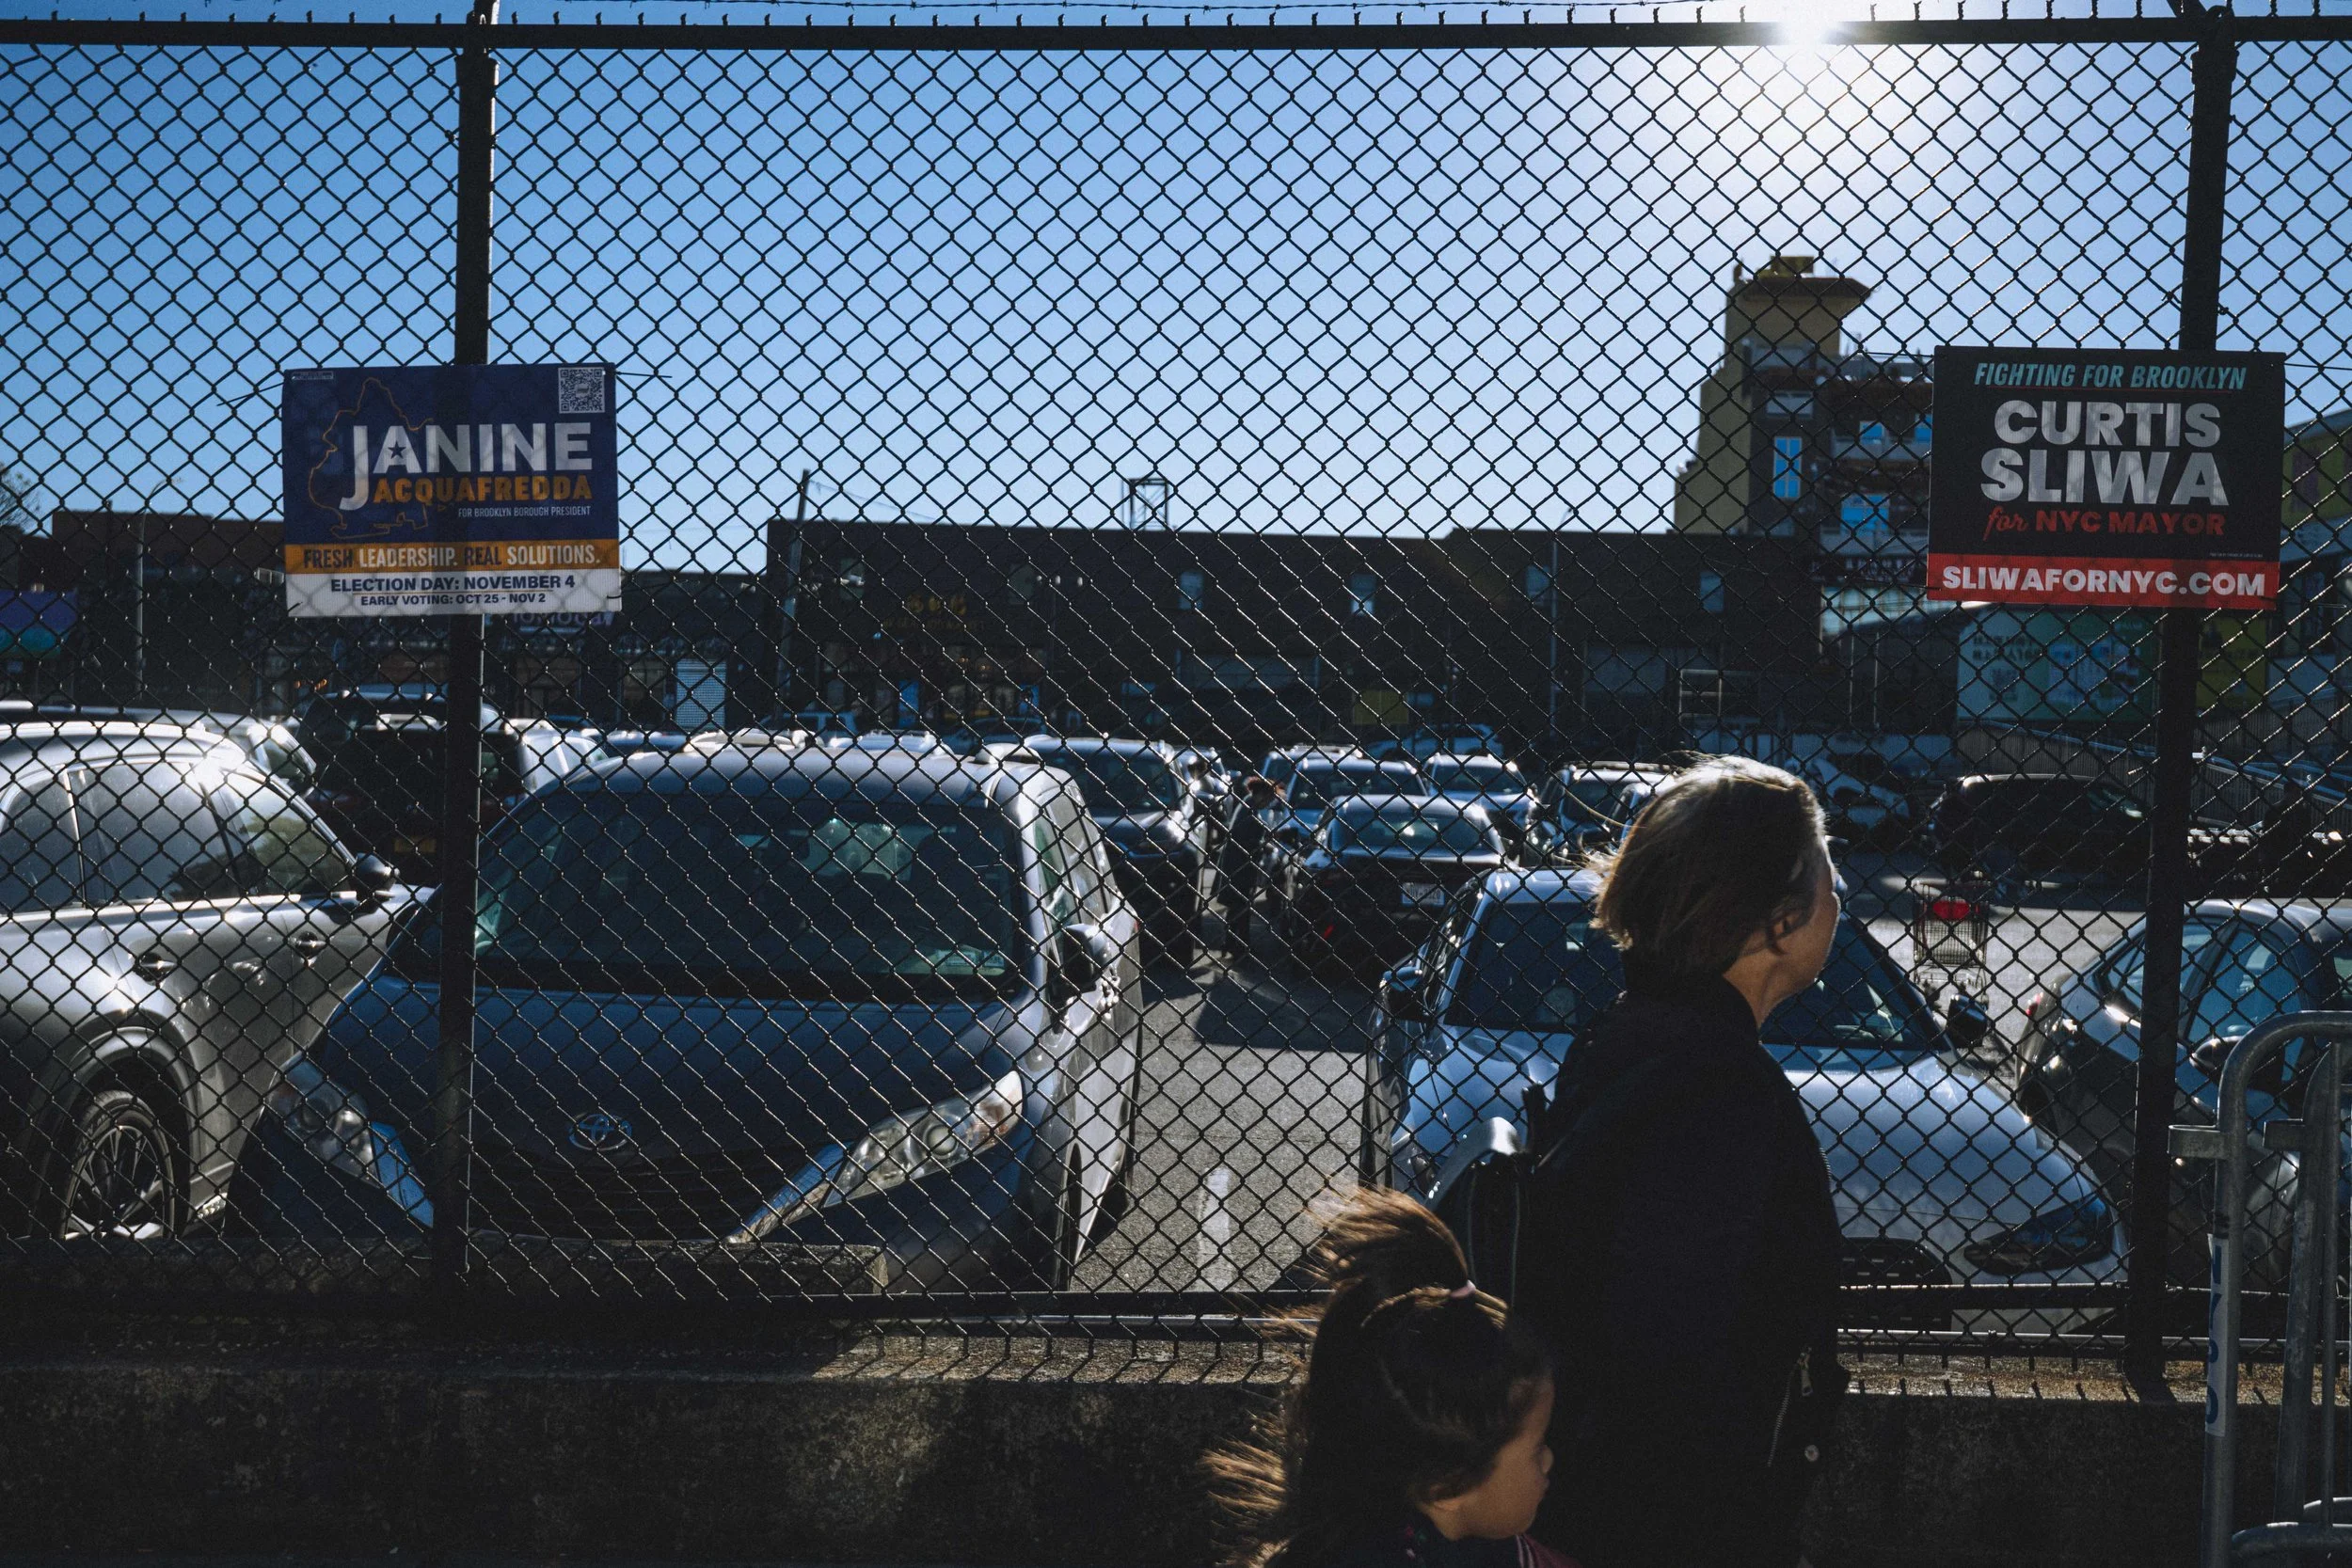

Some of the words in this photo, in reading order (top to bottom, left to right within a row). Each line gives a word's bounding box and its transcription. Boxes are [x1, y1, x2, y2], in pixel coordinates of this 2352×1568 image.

[1974, 363, 2075, 387] FIGHTING
[2082, 364, 2124, 388] FOR
[2130, 365, 2247, 389] BROOKLYN
[1994, 400, 2220, 447] CURTIS
[339, 421, 593, 511] JANINE
[1981, 448, 2230, 506] SLIWA
[373, 475, 593, 503] ACQUAFREDDA
[458, 507, 472, 517] FOR
[474, 507, 512, 517] BROOKLYN
[514, 507, 549, 516] BOROUGH
[551, 506, 591, 515] PRESIDENT
[1983, 505, 2028, 542] for
[2036, 510, 2102, 532] NYC
[2107, 512, 2226, 535] MAYOR
[303, 549, 354, 568] FRESH
[359, 547, 458, 568] LEADERSHIP.
[464, 546, 501, 566] REAL
[506, 544, 601, 564] SOLUTIONS.
[331, 578, 416, 593] ELECTION
[421, 577, 459, 591] DAY:
[464, 576, 562, 590] NOVEMBER
[564, 575, 575, 587] 4
[1942, 566, 2265, 596] SLIWAFORNYC.COM
[361, 595, 399, 606] EARLY
[402, 594, 453, 605] VOTING:
[455, 594, 482, 604] OCT
[484, 594, 499, 604] 25
[509, 593, 535, 604] NOV
[538, 593, 546, 603] 2
